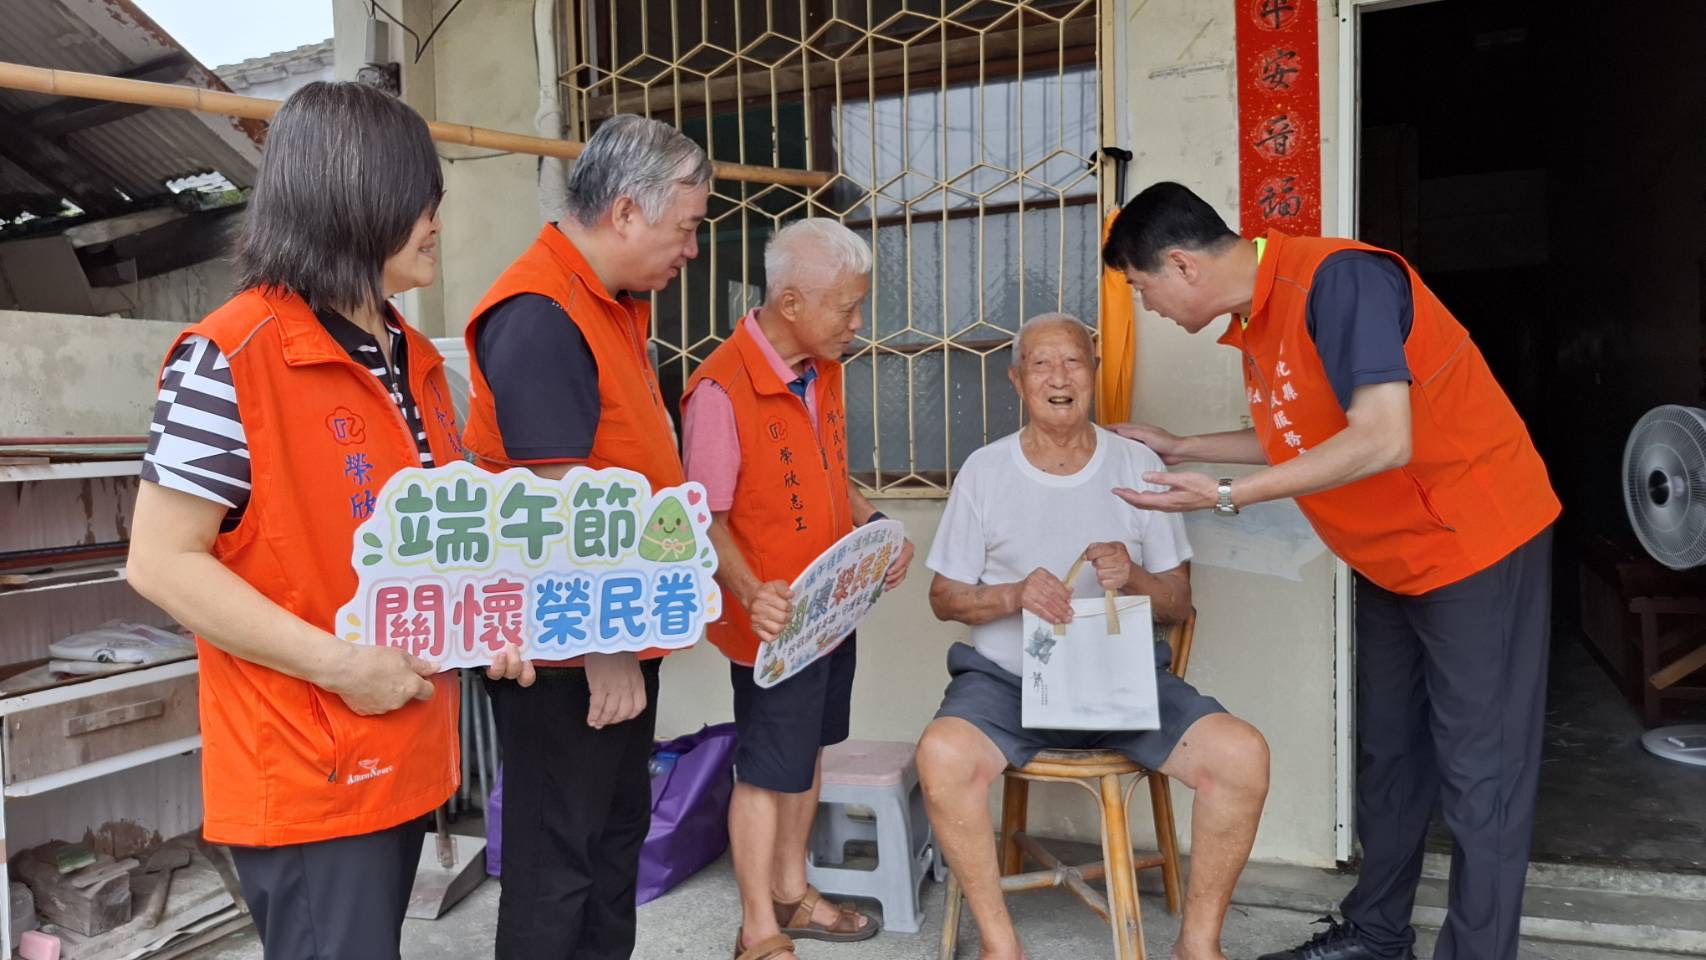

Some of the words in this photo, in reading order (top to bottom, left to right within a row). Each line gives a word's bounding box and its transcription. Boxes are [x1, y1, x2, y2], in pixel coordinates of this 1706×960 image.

[395, 478, 638, 565] 端午節
[374, 572, 698, 657] 關懷榮民眷
